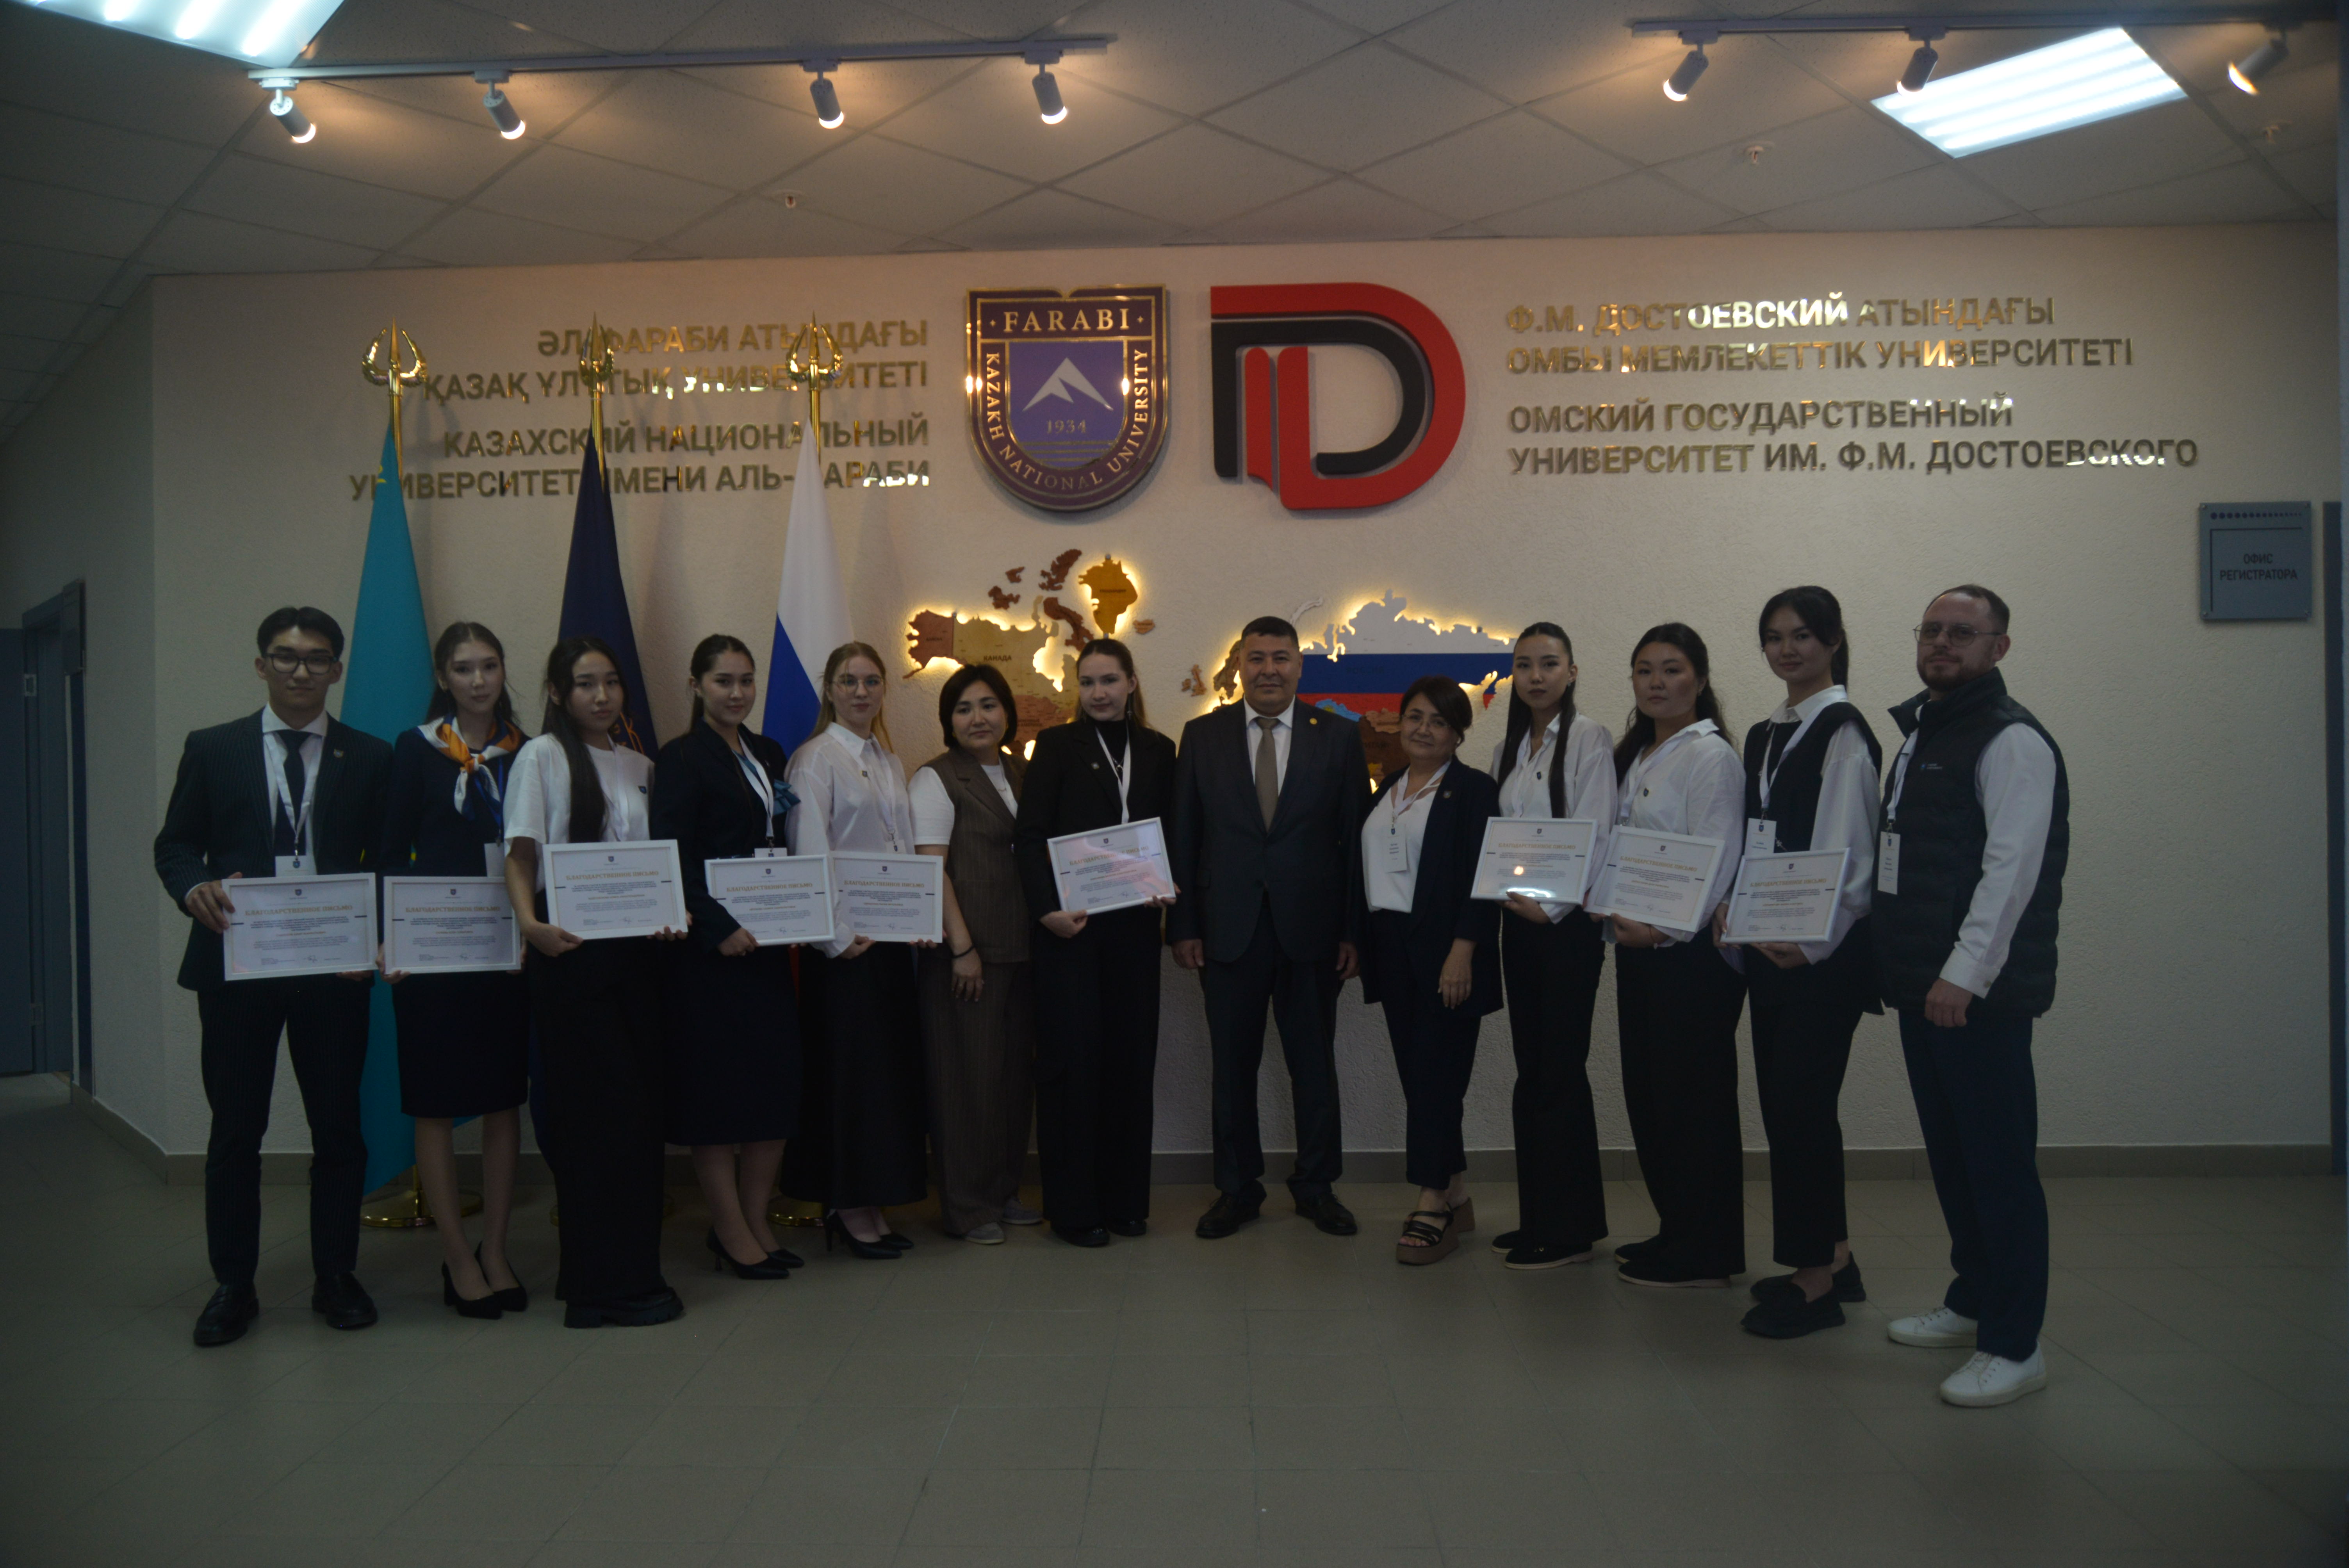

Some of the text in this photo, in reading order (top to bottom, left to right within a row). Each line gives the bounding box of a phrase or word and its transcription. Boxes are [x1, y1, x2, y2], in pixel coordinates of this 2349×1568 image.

[1003, 308, 1130, 332] FARABI
[1507, 292, 2054, 336] Ф.М. ДОСТОЕВСКИЙ АТЫНДАҒЫ
[538, 325, 728, 356] ӘЛФАРАБИ
[1508, 338, 2133, 374] ОМБЫ МЕМЛЕКЕТТІК УНИВЕРСИТЕТІ
[423, 361, 927, 406] ҚАЗАҚ ҰЛТЫҚ УНИВЕИТЕТІ
[986, 352, 1005, 440] KAZAKH
[1047, 419, 1087, 434] 1934
[1107, 349, 1148, 474] UNIVERSITY
[1510, 391, 2012, 435] ОМСКИЙ ГОСУДАРСТВЕННЫЙ
[999, 444, 1103, 490] NATIONAL
[1509, 439, 2198, 474] УНИВЕРСИТЕТ ИМ. Ф.М. ДОСТОЕВСКОГО
[606, 465, 704, 493] МЕНИ
[716, 460, 929, 491] АЛЬ-АРАБИ
[2219, 569, 2298, 581] РЕГИСТРАТОРА
[2243, 553, 2273, 564] ОФИС
